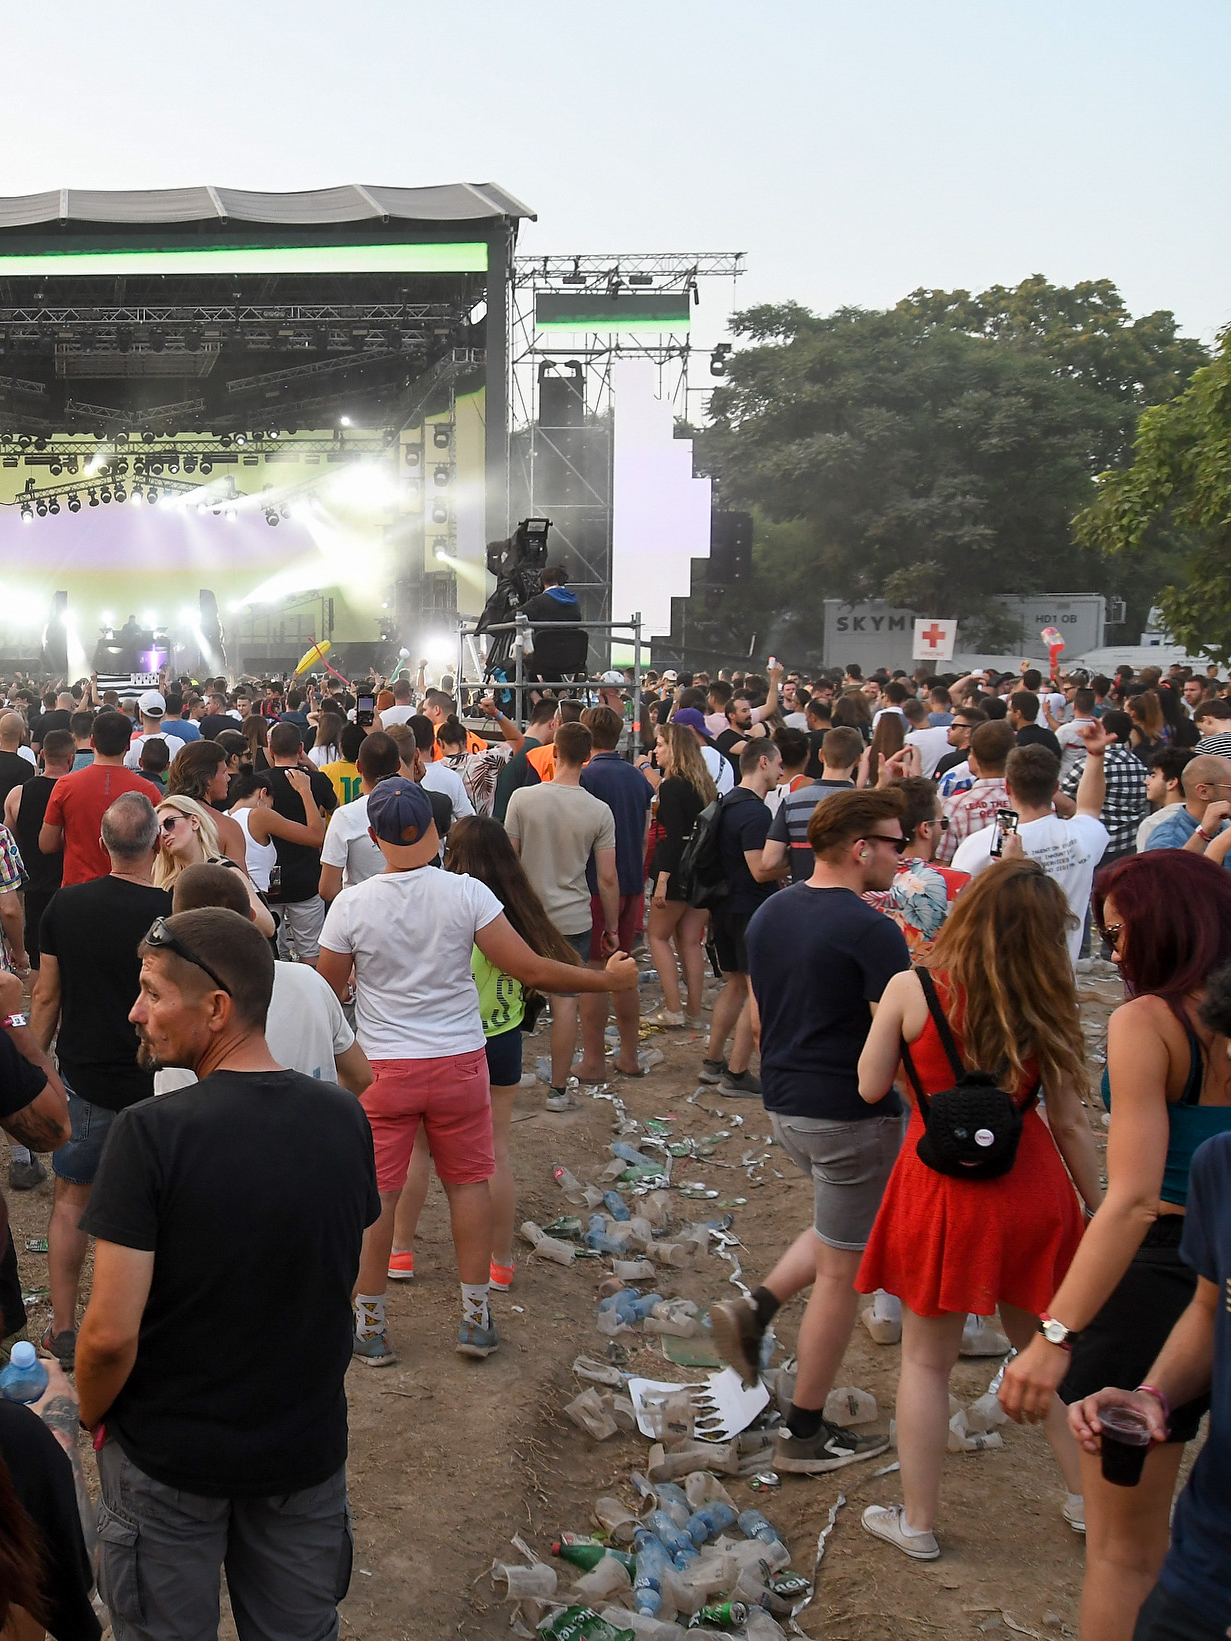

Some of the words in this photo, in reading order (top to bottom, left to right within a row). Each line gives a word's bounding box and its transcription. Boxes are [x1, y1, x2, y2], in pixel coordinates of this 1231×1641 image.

[1035, 615, 1057, 624] HD1
[1061, 615, 1077, 624] OB
[964, 801, 987, 810] LEAD
[989, 800, 1009, 808] THE
